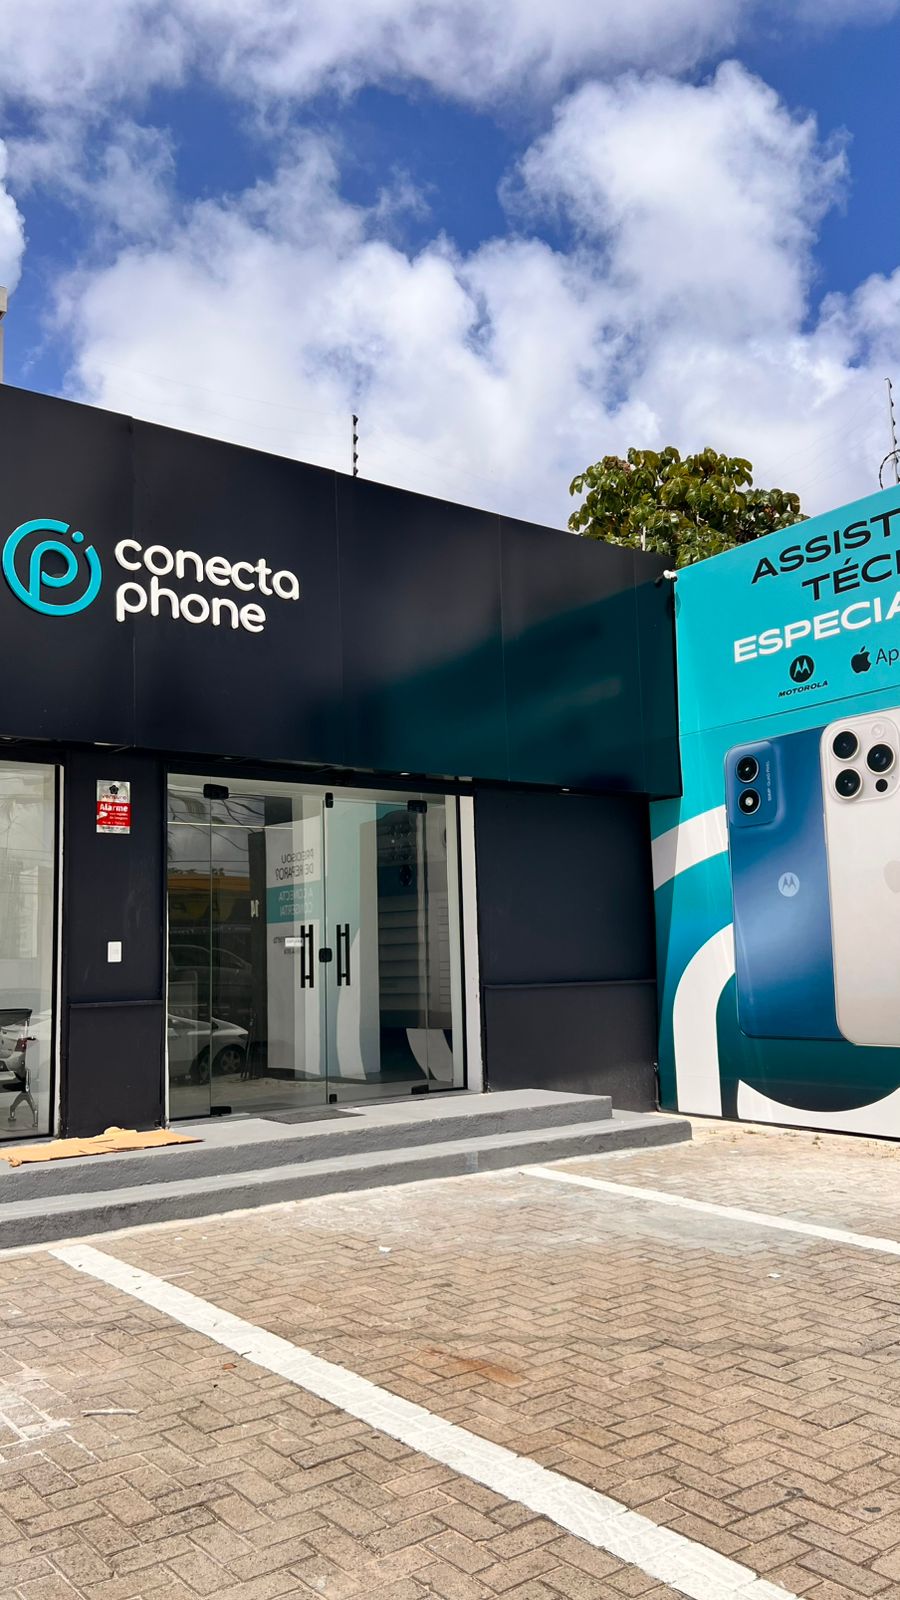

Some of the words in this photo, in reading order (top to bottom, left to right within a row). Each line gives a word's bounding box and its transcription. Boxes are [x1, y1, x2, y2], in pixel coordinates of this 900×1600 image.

[114, 539, 299, 600] conecta
[752, 508, 900, 584] ASSIST
[802, 550, 900, 600] TÉC
[116, 576, 266, 633] phone
[778, 680, 828, 697] MOTOROLA
[100, 803, 128, 812] Alarme
